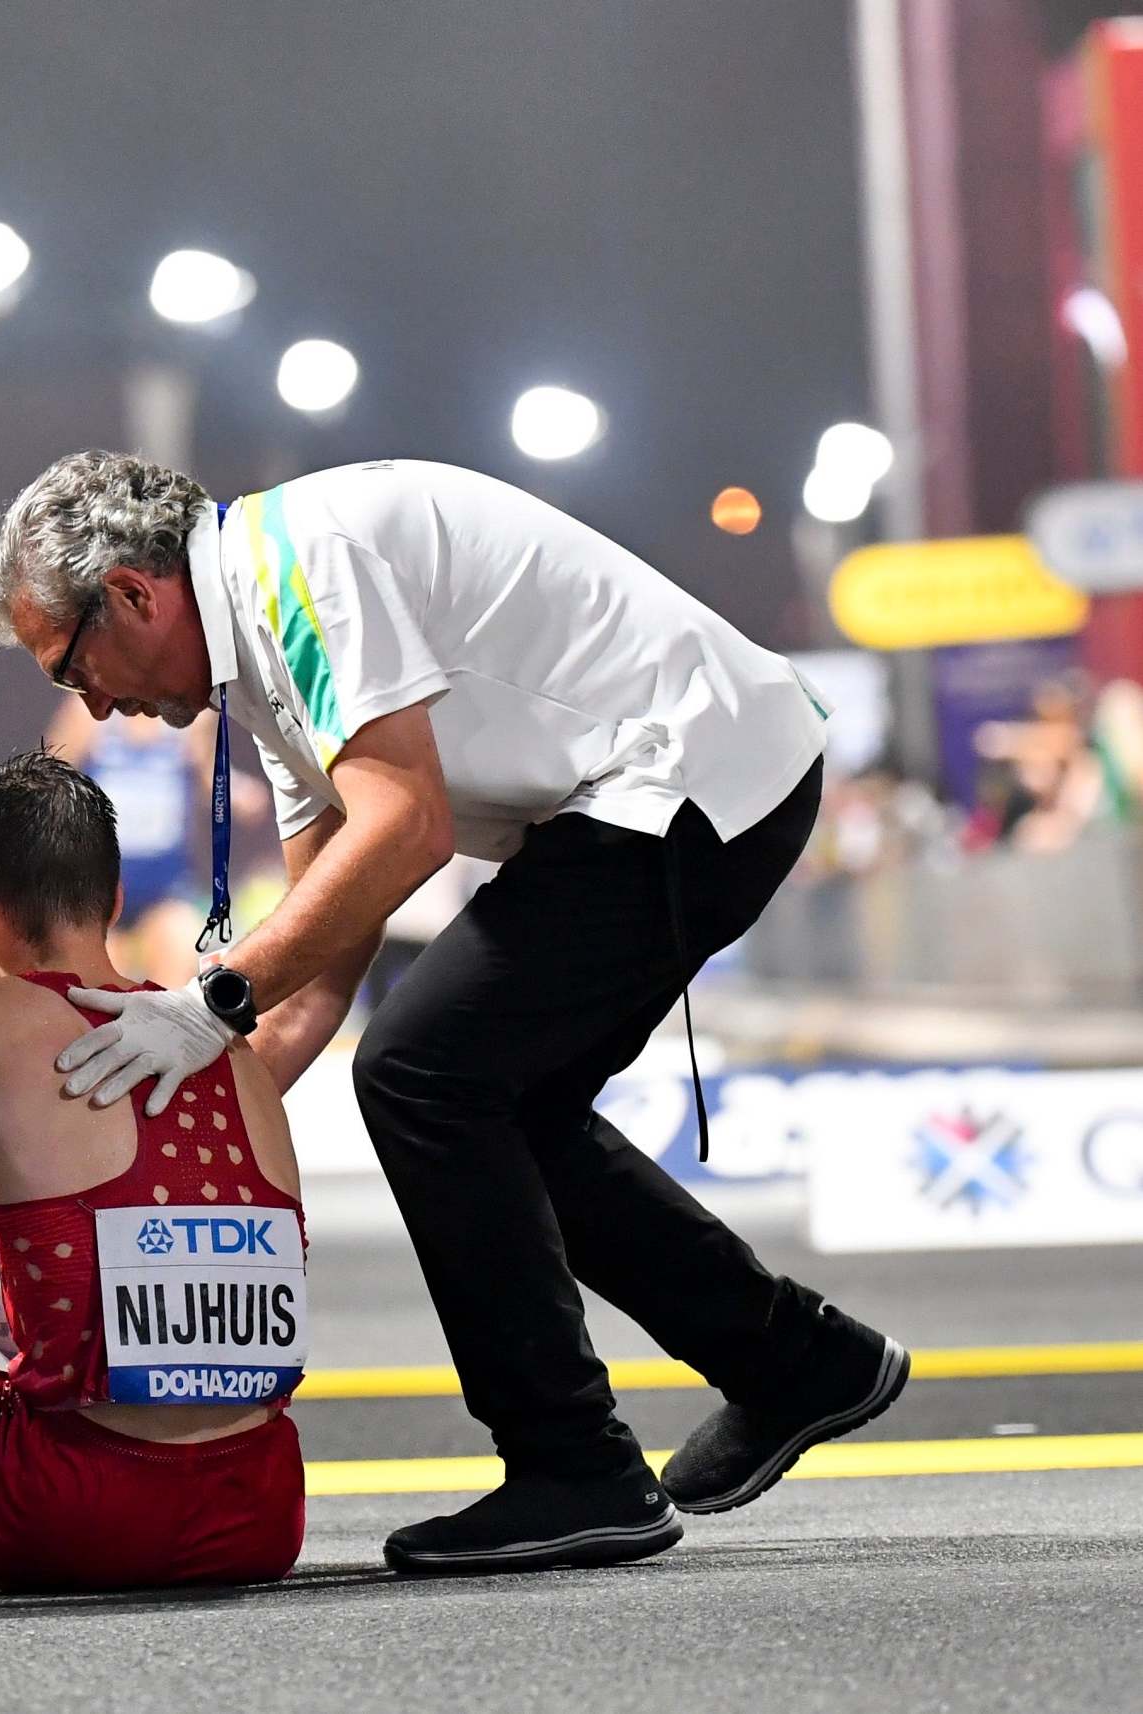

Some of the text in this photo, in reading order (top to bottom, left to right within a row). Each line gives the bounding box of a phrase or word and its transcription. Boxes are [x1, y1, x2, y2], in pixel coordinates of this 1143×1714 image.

[171, 1218, 277, 1256] TDK
[115, 1283, 296, 1347] NIJHUIS
[148, 1369, 278, 1399] DOHA2019
